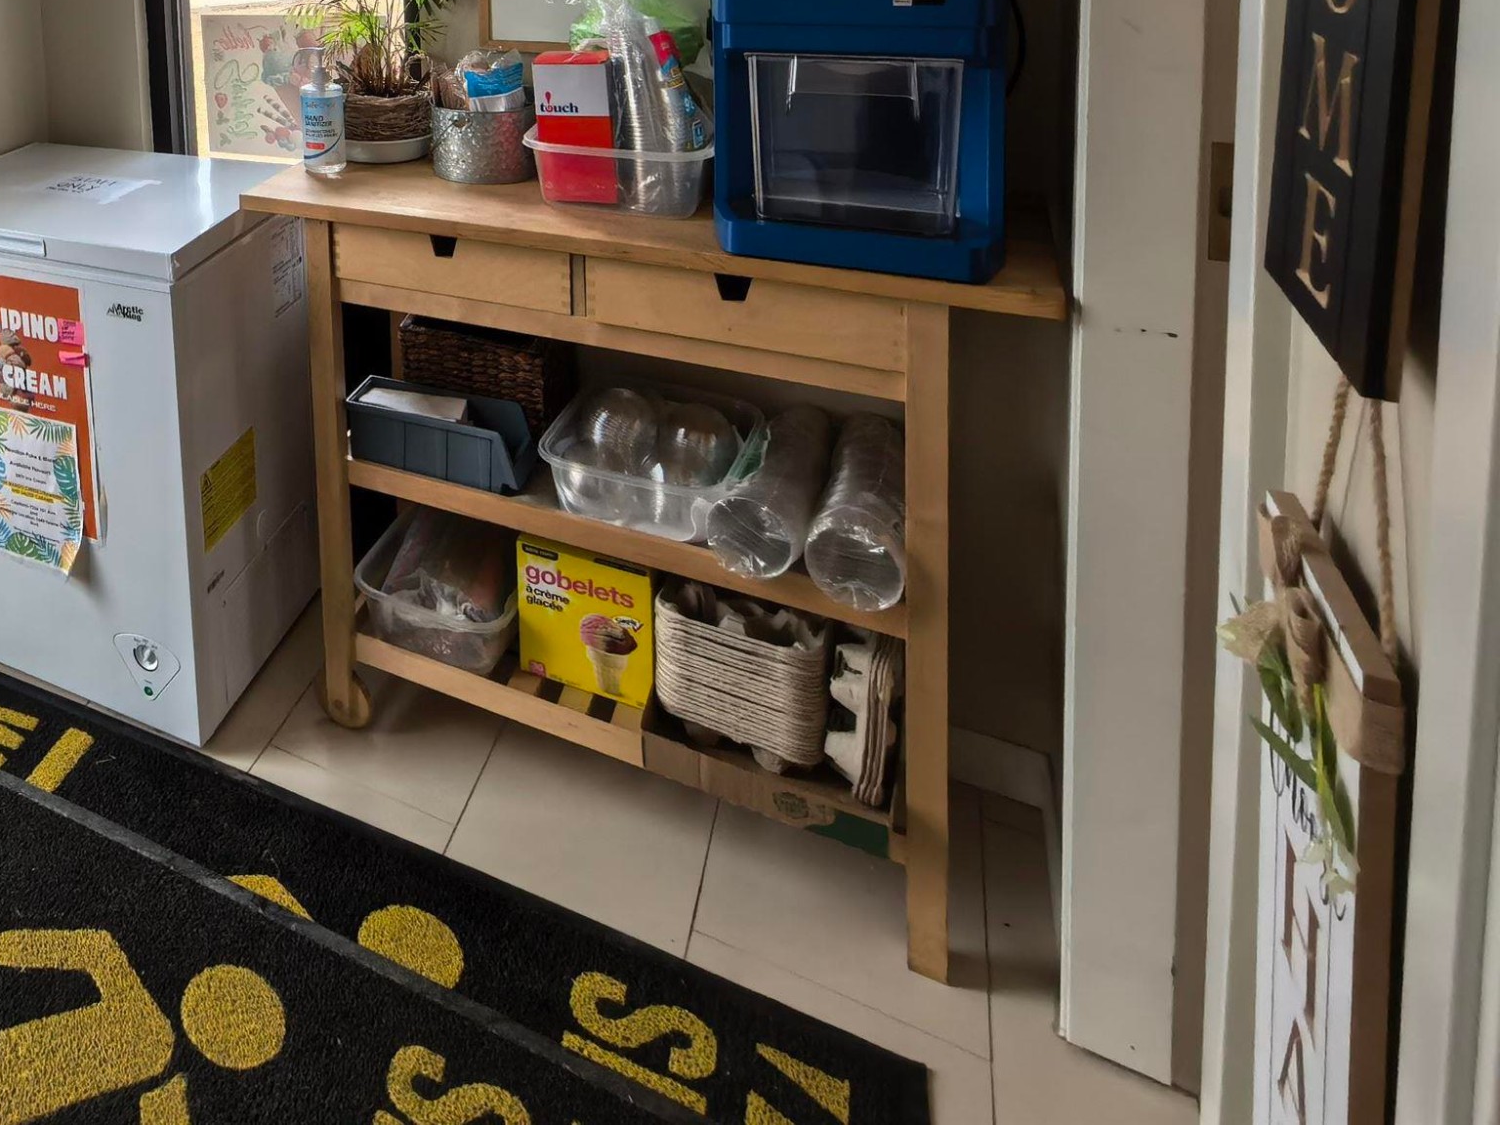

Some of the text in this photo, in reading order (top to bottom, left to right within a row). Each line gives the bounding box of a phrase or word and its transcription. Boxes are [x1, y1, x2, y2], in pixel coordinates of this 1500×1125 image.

[540, 102, 579, 114] touch
[116, 303, 144, 315] Arctic
[2, 364, 68, 400] CREAM
[31, 399, 57, 412] HERE
[525, 565, 635, 609] gobelets
[525, 583, 570, 605] à crème
[526, 594, 564, 612] glacée
